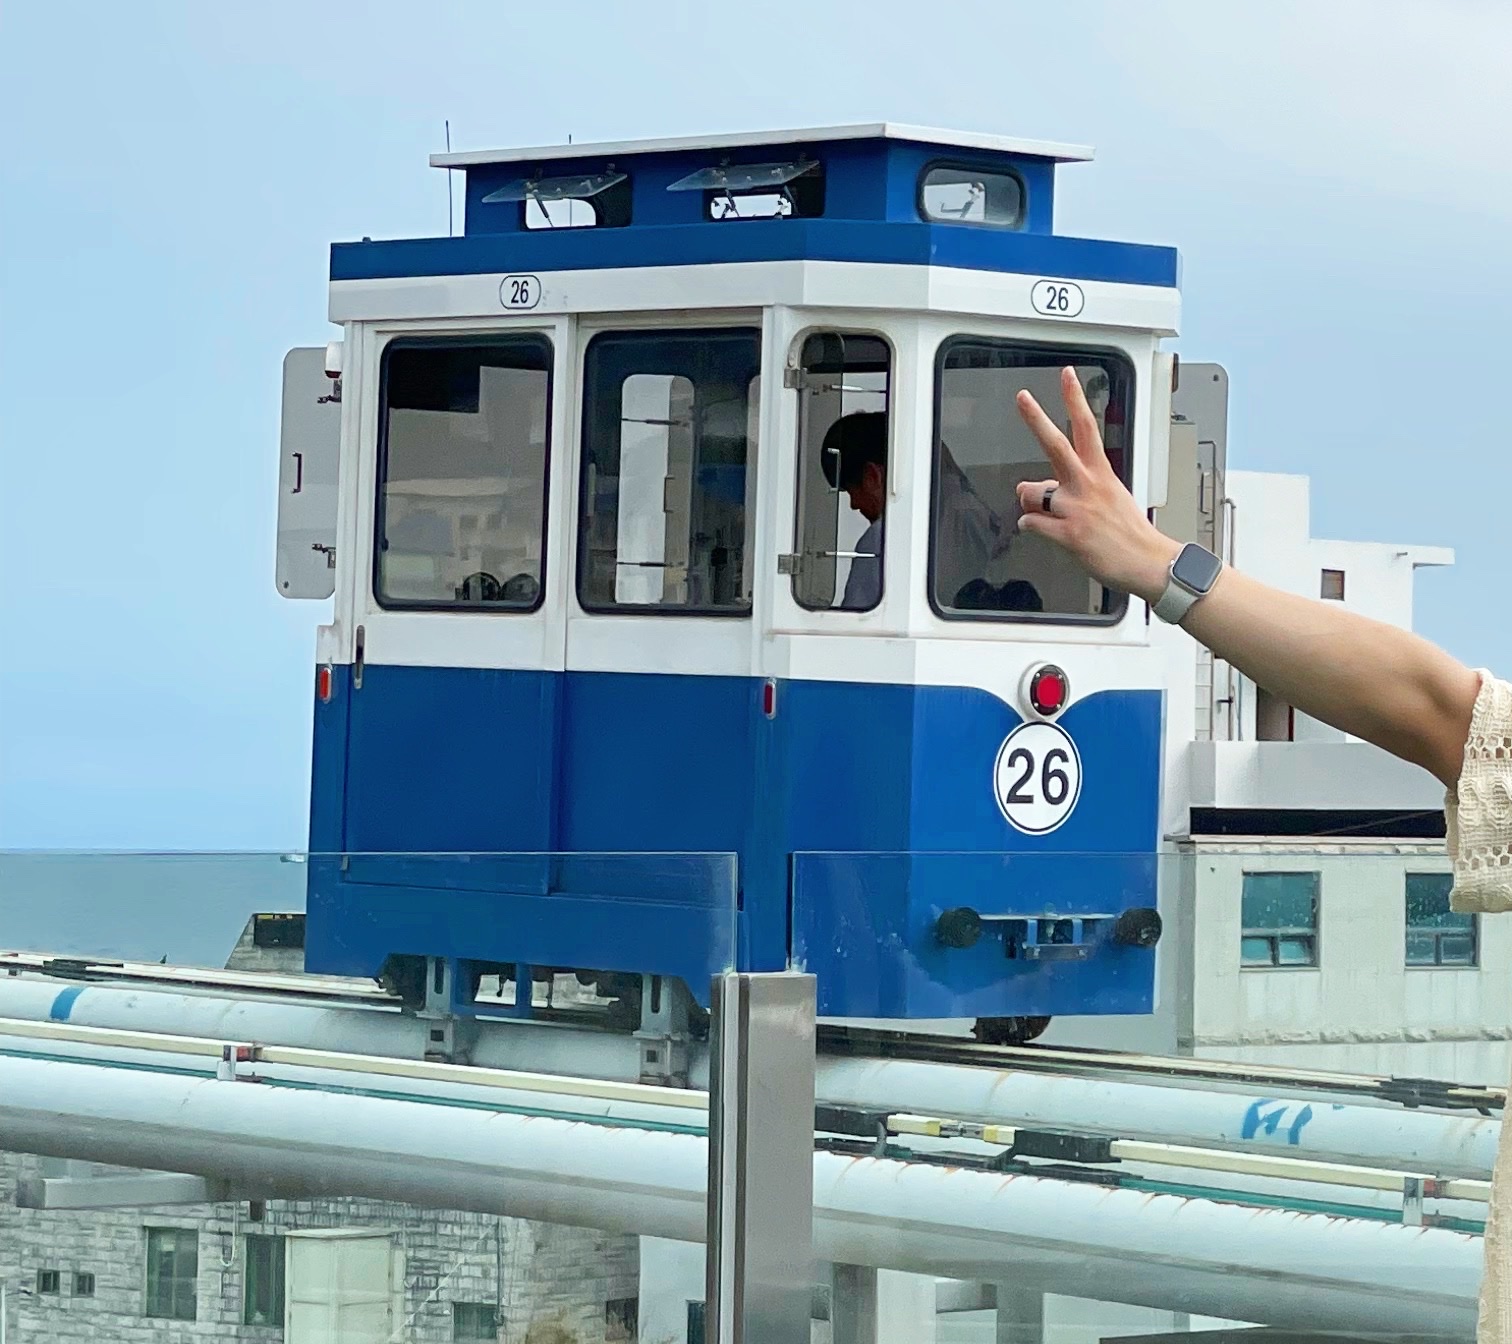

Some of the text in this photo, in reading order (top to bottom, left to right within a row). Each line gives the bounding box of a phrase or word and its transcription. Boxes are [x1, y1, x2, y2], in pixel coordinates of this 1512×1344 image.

[511, 280, 529, 304] 26
[1046, 285, 1069, 311] 26
[1006, 747, 1069, 806] 26
